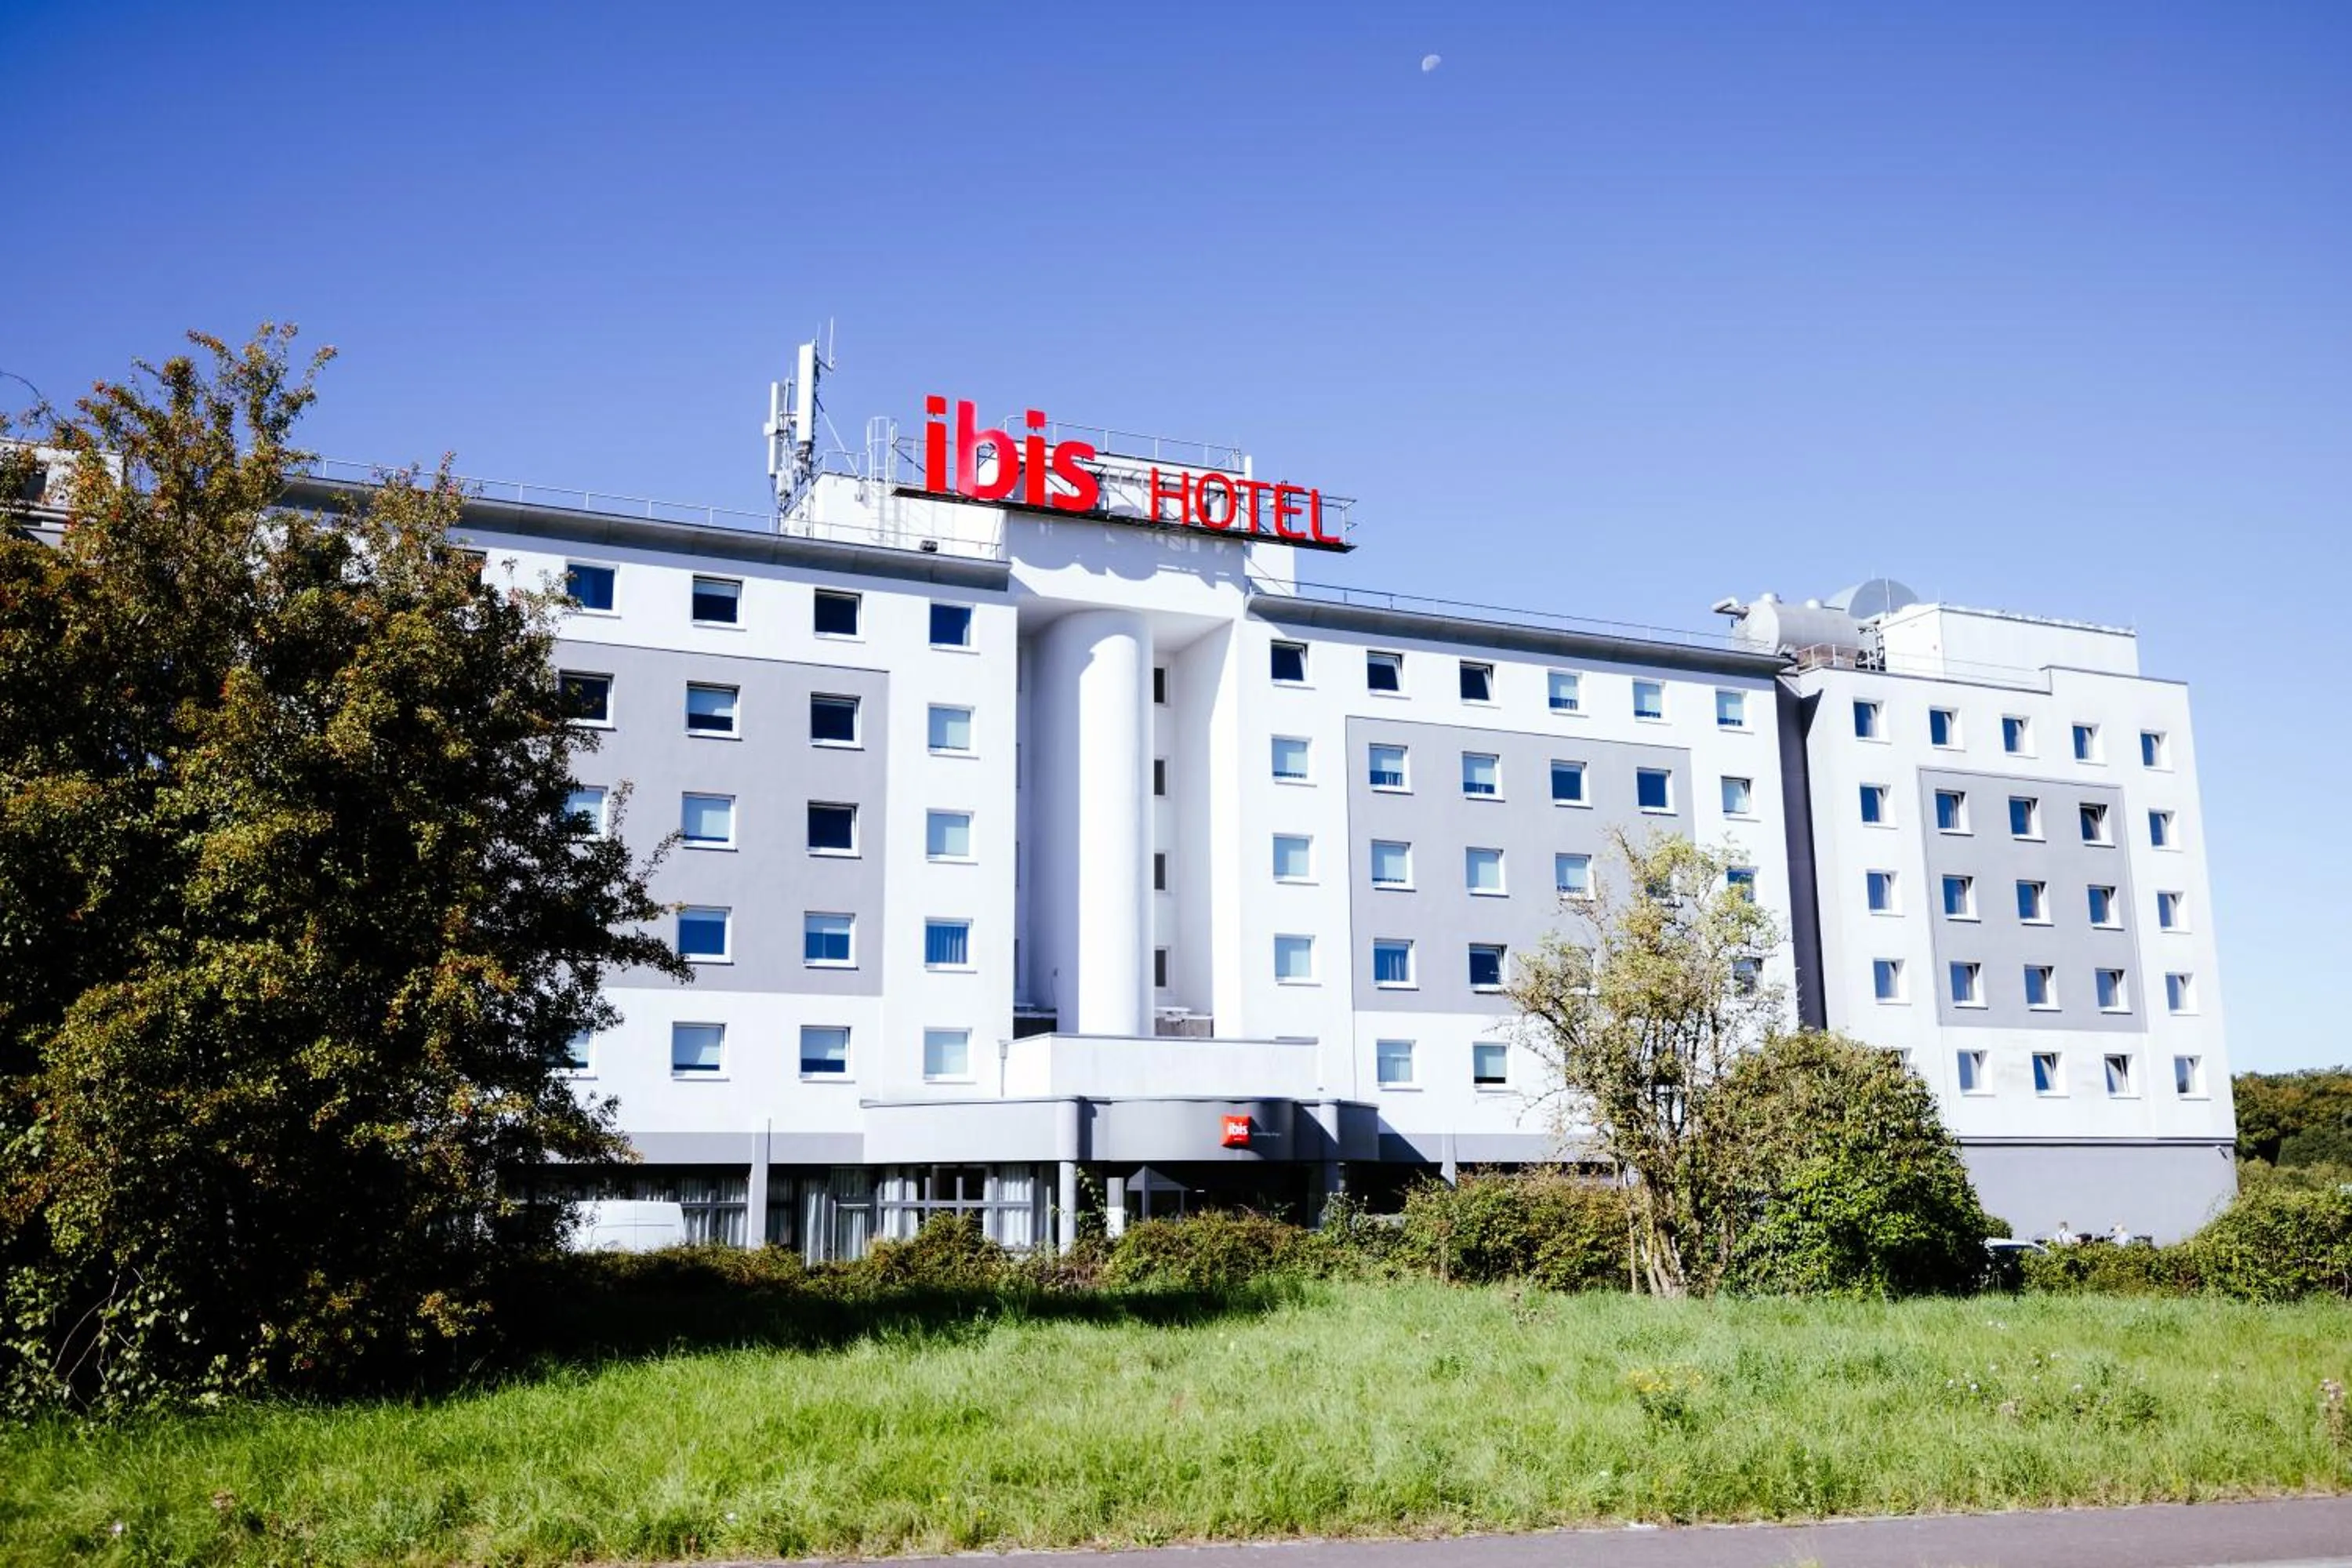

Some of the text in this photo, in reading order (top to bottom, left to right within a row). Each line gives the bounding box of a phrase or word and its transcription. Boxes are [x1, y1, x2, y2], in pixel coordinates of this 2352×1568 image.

[925, 395, 1340, 543] ibis HOTEL
[1229, 1122, 1248, 1136] ibis
